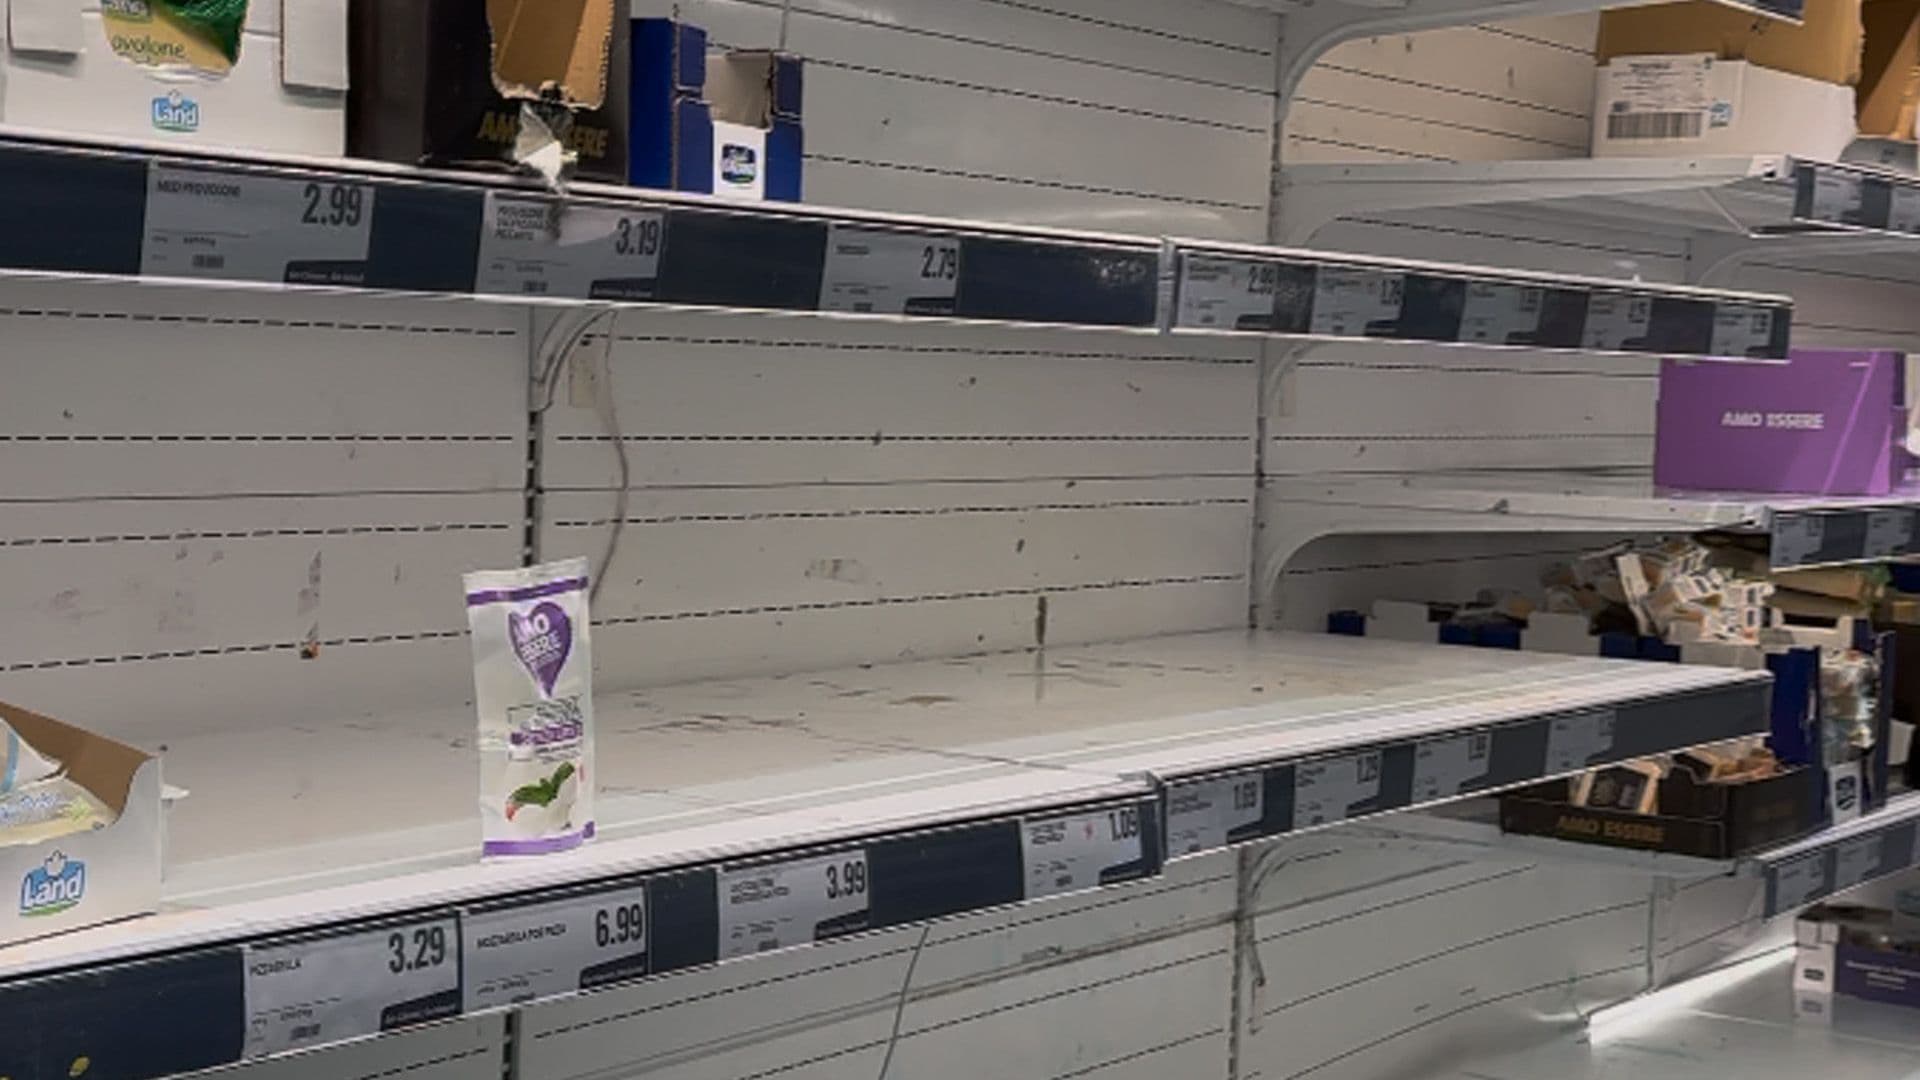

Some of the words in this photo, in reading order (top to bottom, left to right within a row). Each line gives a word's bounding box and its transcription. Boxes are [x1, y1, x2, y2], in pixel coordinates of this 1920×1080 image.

[111, 33, 187, 60] ovolone
[154, 100, 199, 127] Land
[477, 111, 520, 143] AM
[303, 183, 362, 227] 2.99
[615, 218, 659, 256] 3.19
[1721, 411, 1762, 427] AMO
[1109, 809, 1137, 842] 1.09
[22, 868, 83, 909] Land
[827, 860, 866, 899] 3.99
[595, 903, 643, 948] 6.99
[388, 925, 447, 974] 3.29
